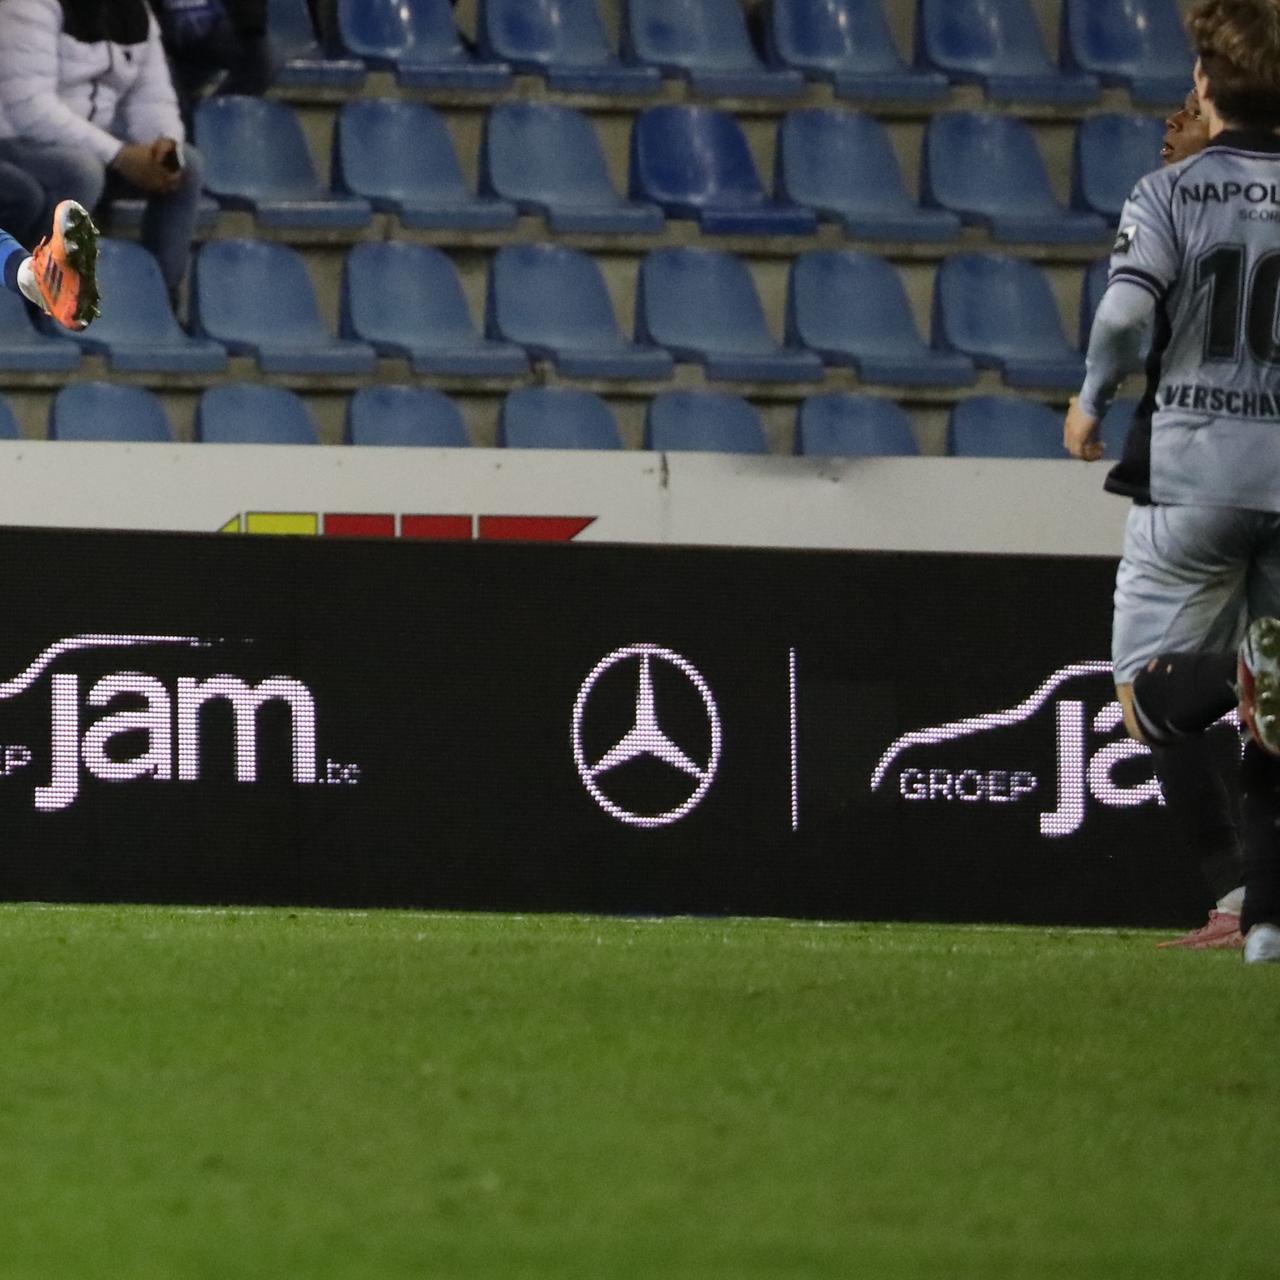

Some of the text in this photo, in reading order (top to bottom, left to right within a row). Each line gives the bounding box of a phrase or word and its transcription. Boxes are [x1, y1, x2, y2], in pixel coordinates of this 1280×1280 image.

[1165, 385, 1280, 416] VERSCHA
[35, 670, 317, 812] jam
[899, 700, 1167, 838] GROEP ja
